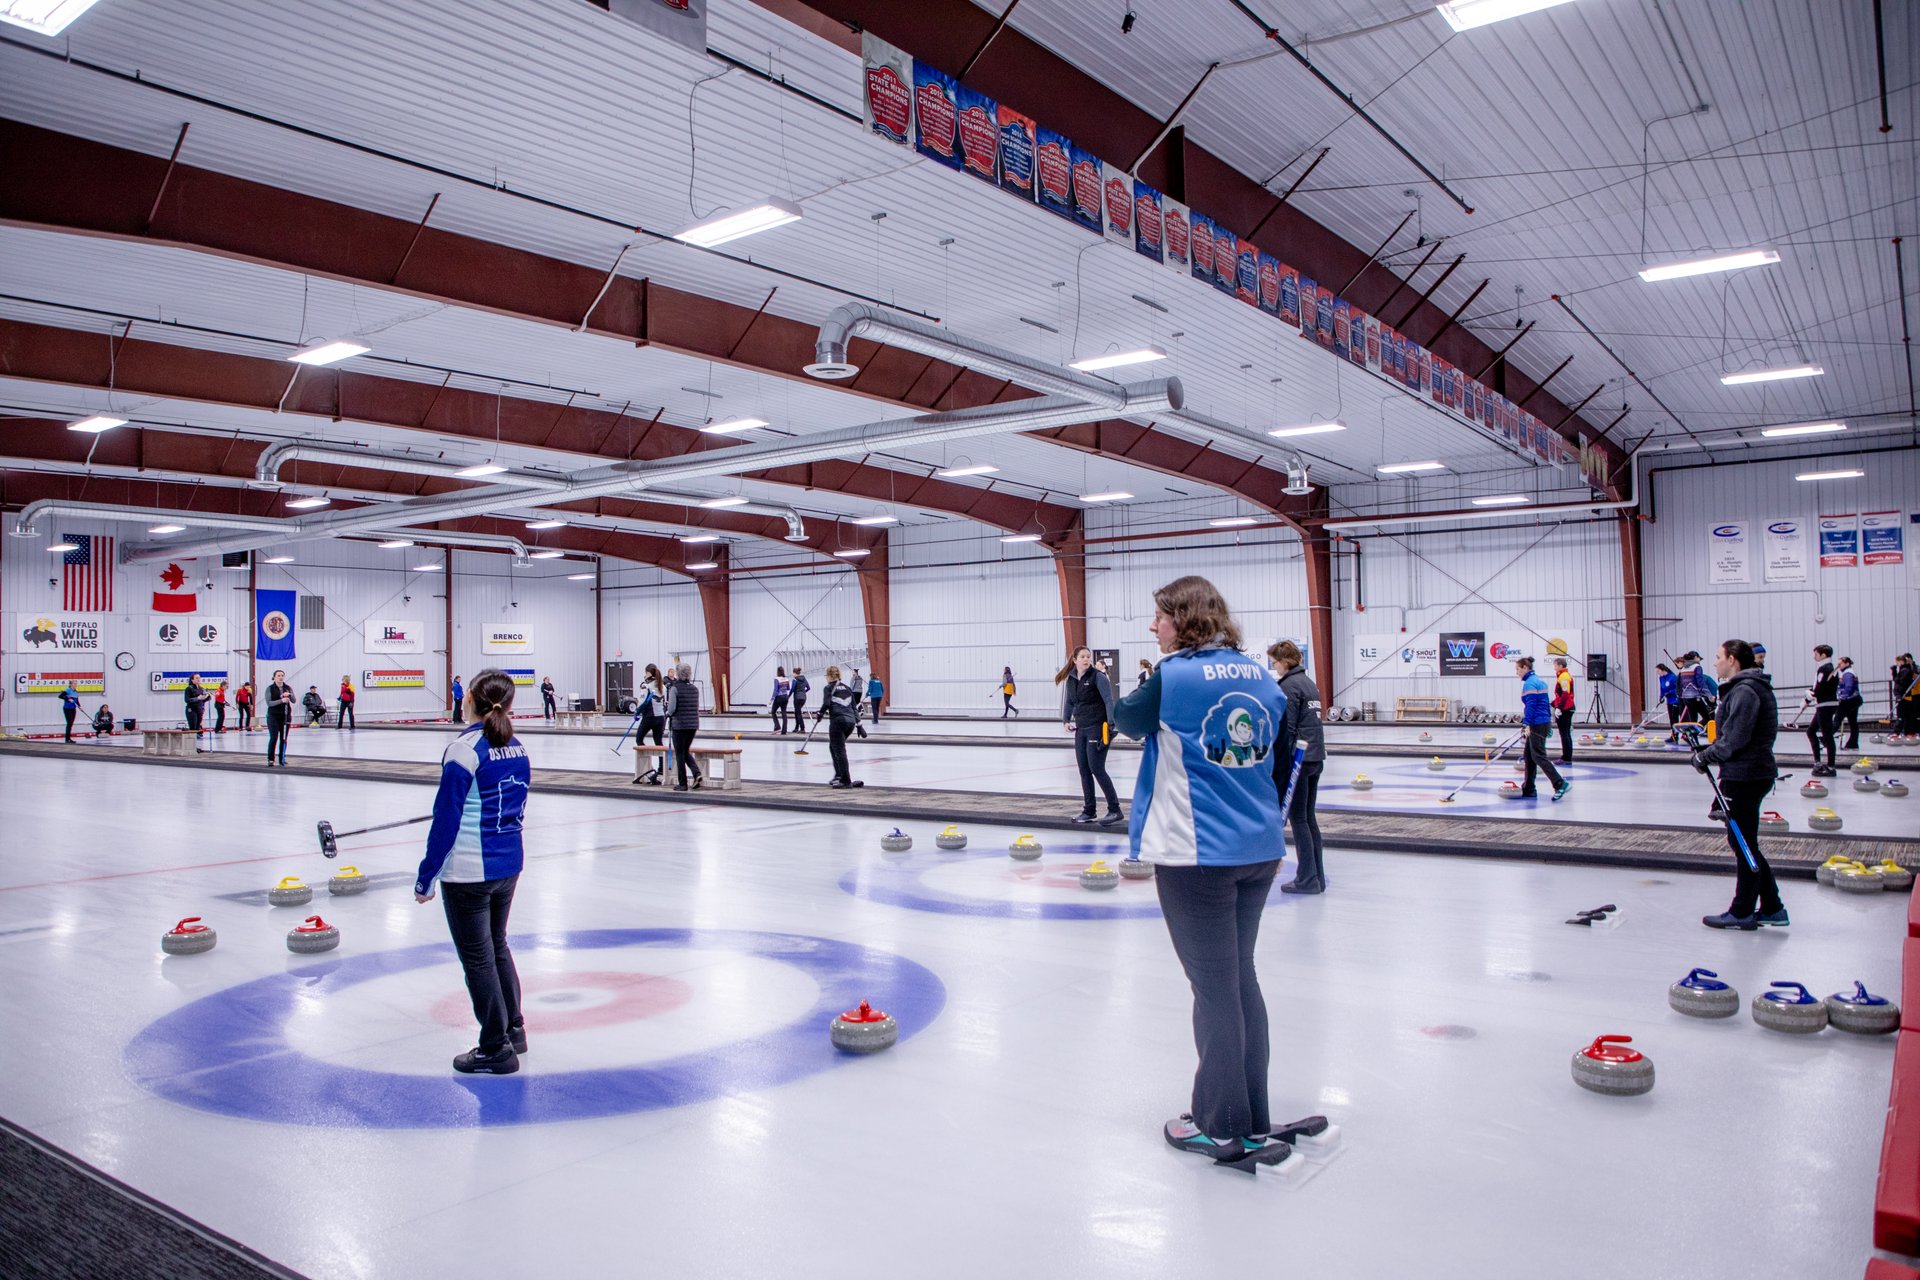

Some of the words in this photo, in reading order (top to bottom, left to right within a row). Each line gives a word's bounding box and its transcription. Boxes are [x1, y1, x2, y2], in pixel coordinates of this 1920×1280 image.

[882, 72, 897, 85] 2011
[869, 73, 889, 88] STATE
[889, 83, 909, 99] MIXED
[870, 83, 908, 106] CHAMPIONS
[929, 87, 943, 99] 2012
[918, 96, 954, 119] CHAMPIONS
[971, 109, 985, 120] 2013
[960, 119, 996, 140] CHAMPIONS
[1001, 138, 1032, 157] CHAMPIONS
[1040, 155, 1069, 173] CHAMPIONS
[1075, 173, 1101, 191] CHAMPIONS
[1107, 193, 1130, 209] CHAMPIONS
[61, 621, 98, 629] BUFFALO
[61, 628, 98, 640] WILD
[61, 640, 98, 648] WINGS
[1360, 648, 1377, 658] RLE
[154, 674, 162, 682] D
[366, 672, 372, 680] E
[1202, 663, 1262, 681] BROWN
[18, 675, 27, 684] C
